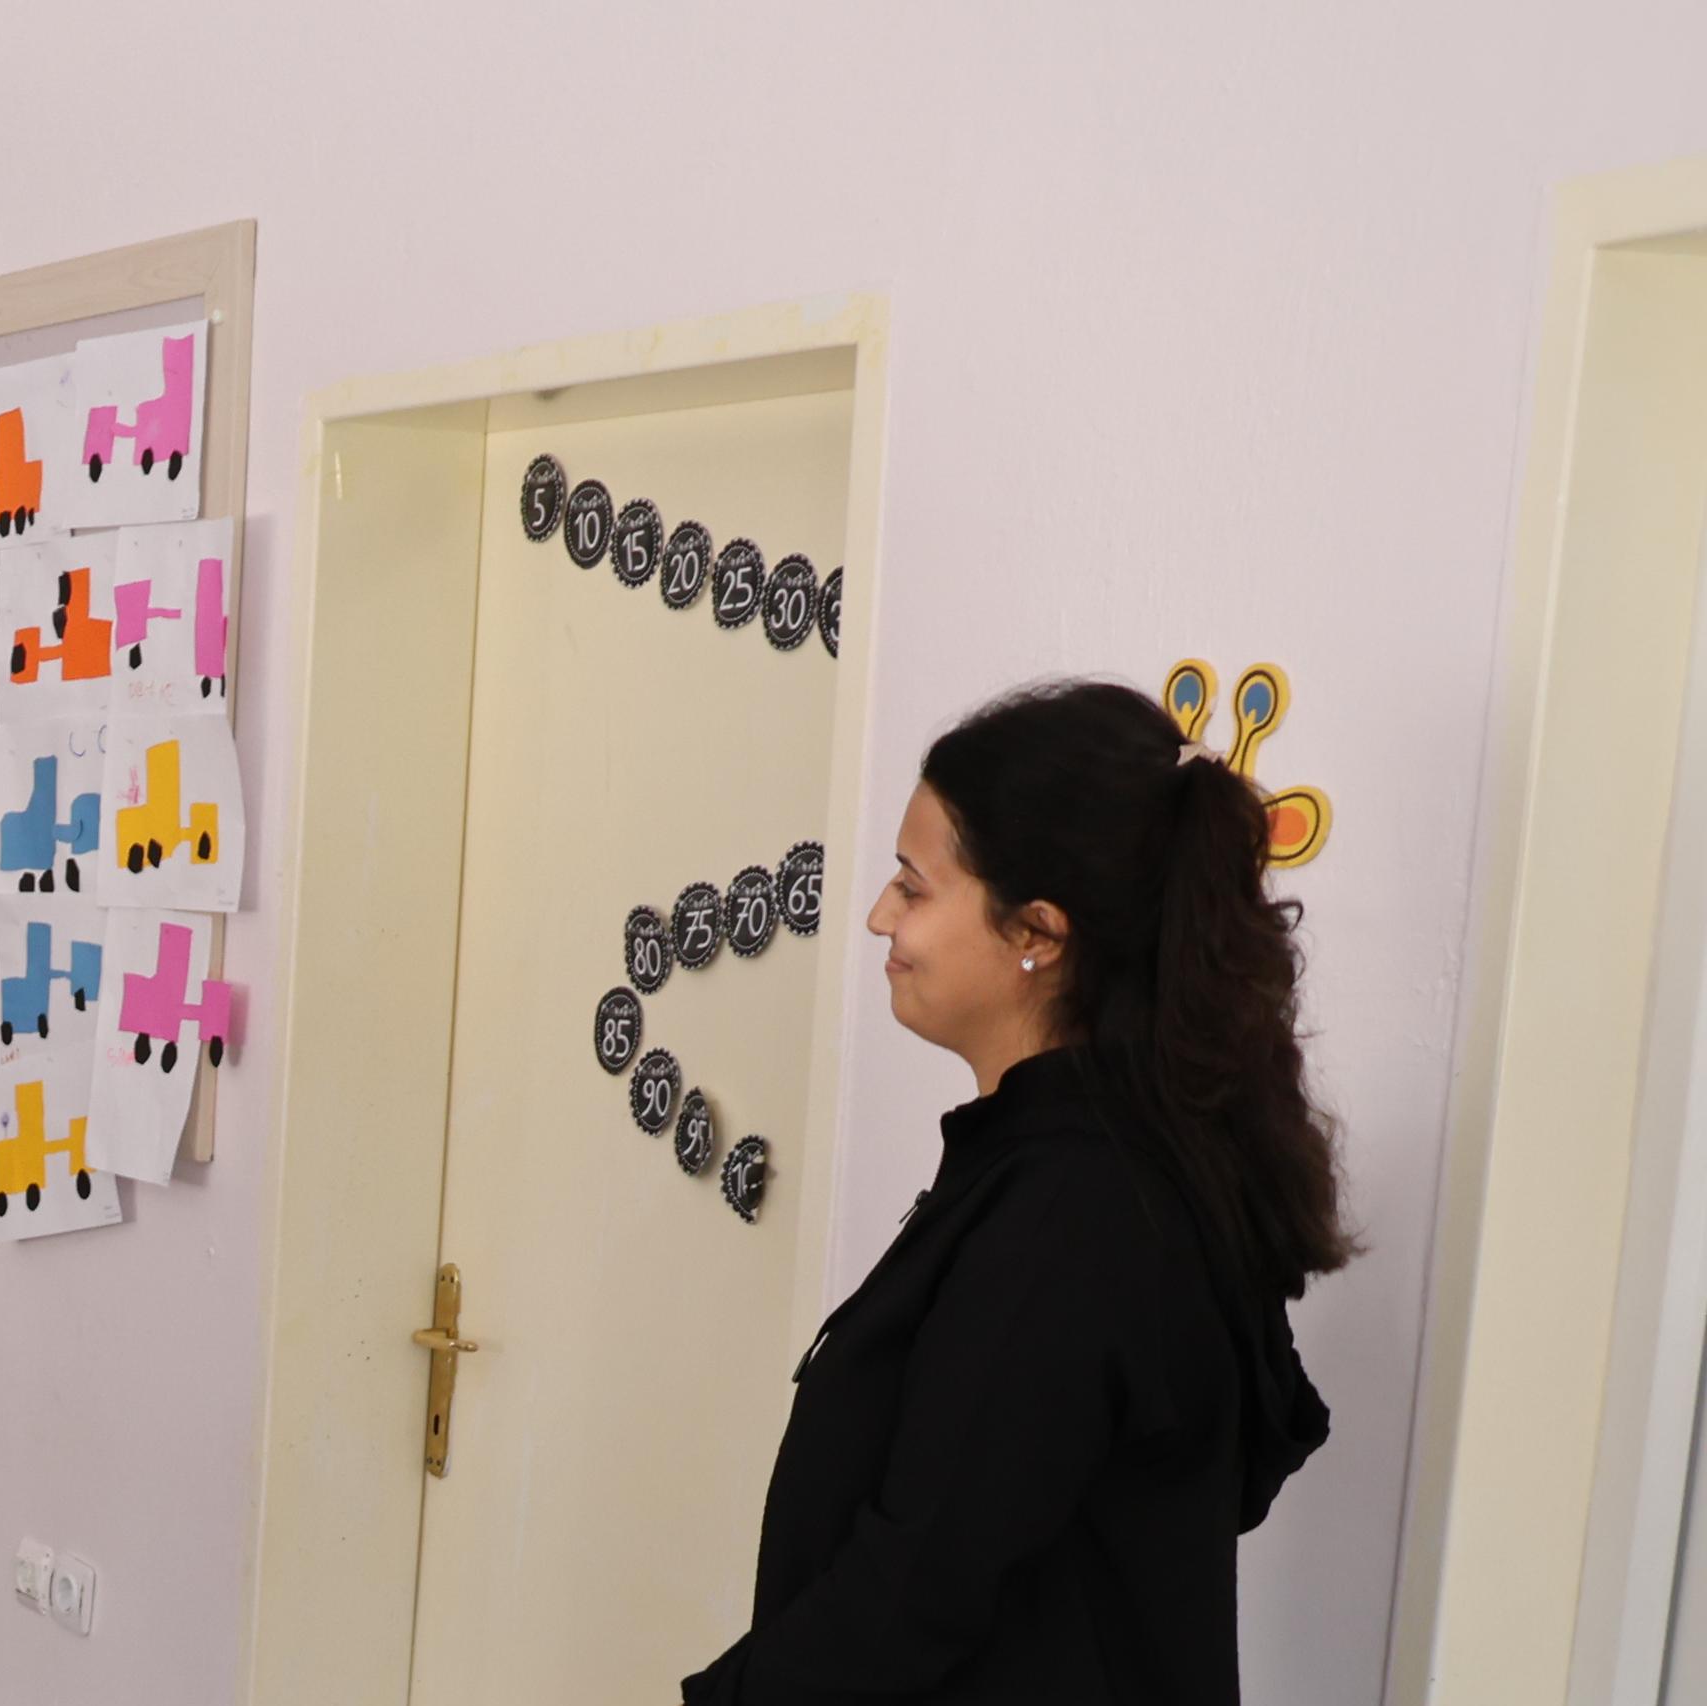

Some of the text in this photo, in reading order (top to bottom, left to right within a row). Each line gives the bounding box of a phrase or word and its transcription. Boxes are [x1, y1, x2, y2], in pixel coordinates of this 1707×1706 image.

[532, 487, 546, 527] 5
[574, 511, 600, 550] 10
[623, 530, 648, 572] 15
[667, 551, 699, 595] 20
[719, 566, 753, 611] 25
[770, 588, 807, 630] 30
[634, 874, 823, 977] 80 75 70 65
[602, 1018, 631, 1058] 85
[640, 1078, 672, 1118] 90
